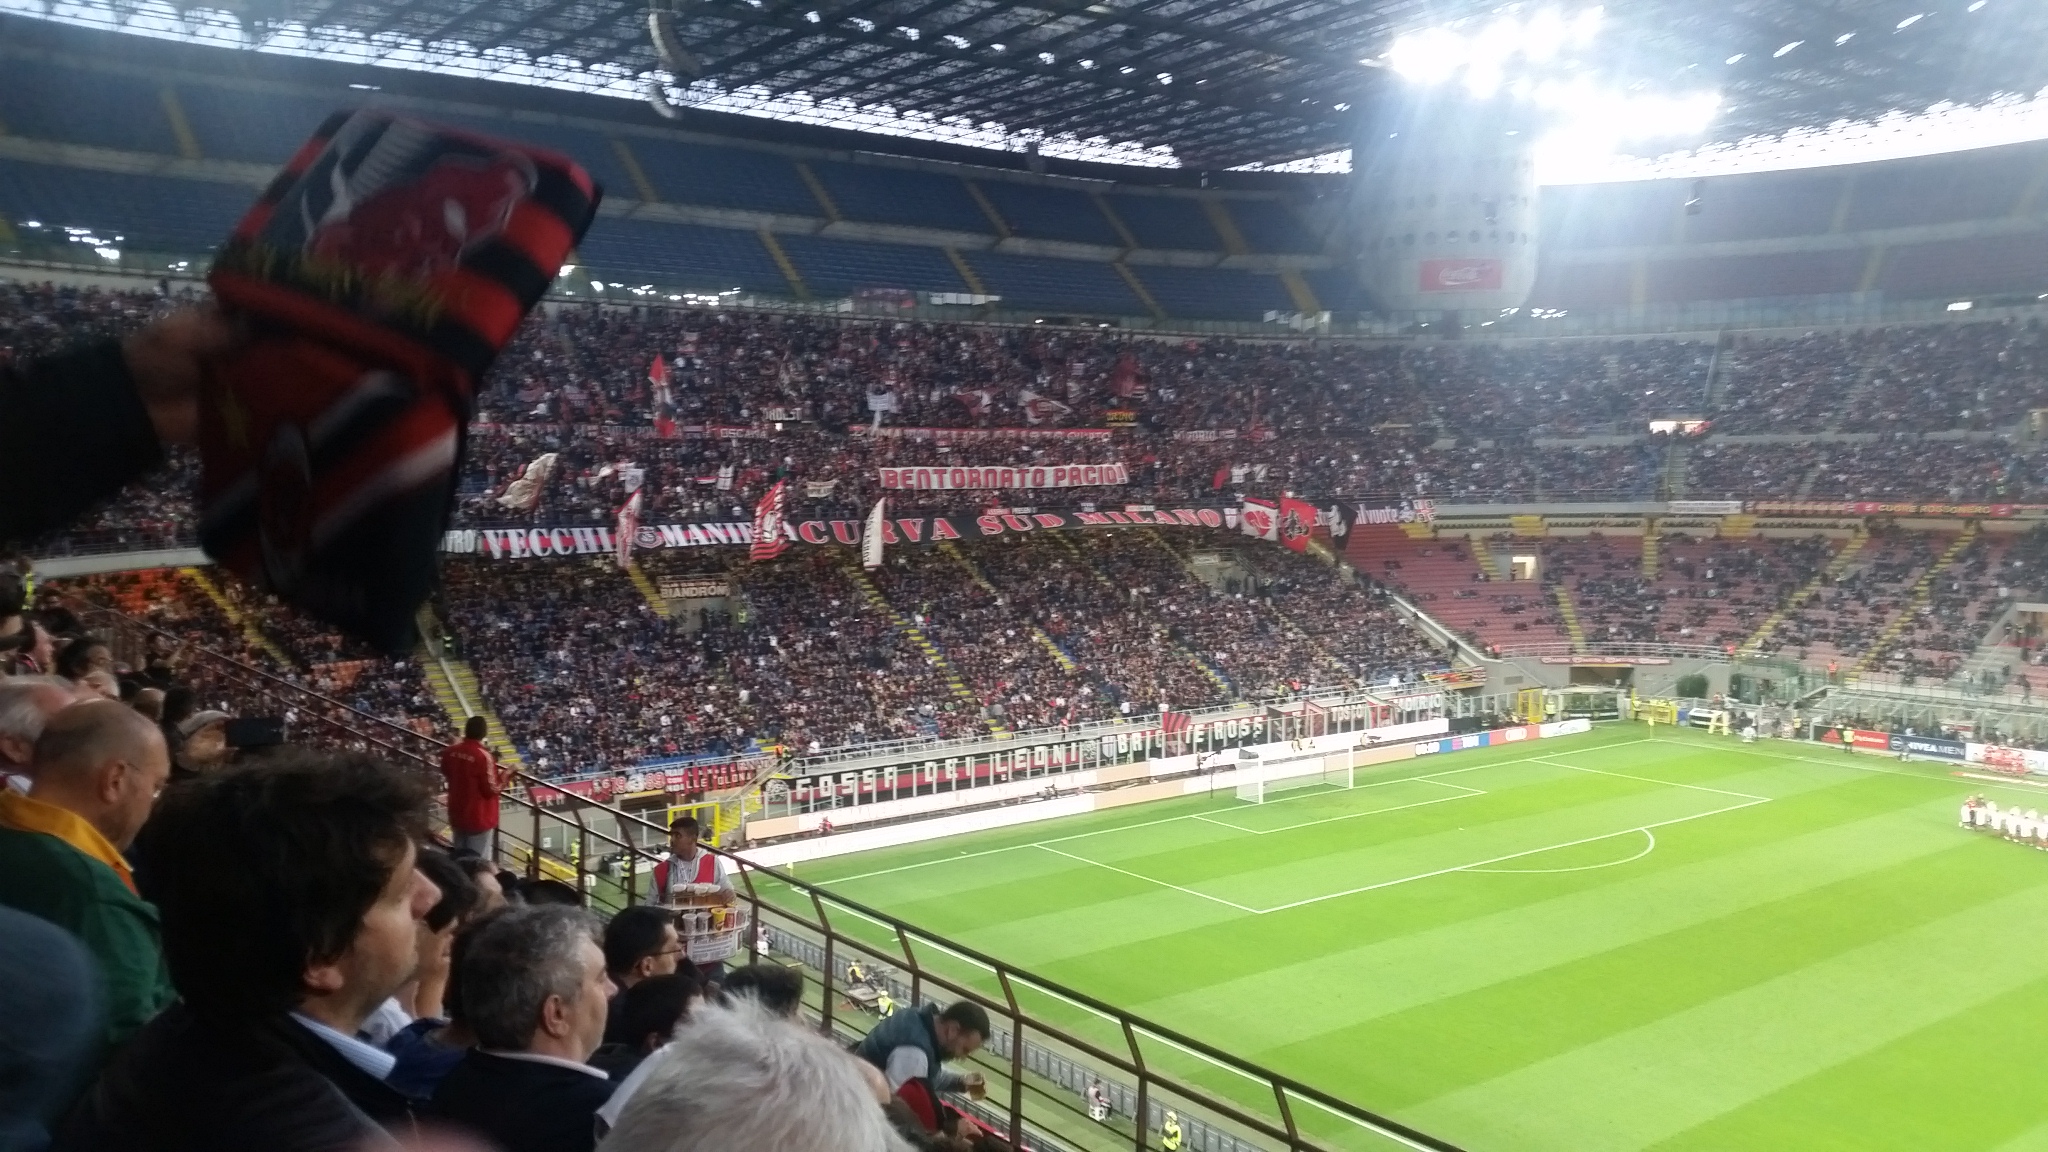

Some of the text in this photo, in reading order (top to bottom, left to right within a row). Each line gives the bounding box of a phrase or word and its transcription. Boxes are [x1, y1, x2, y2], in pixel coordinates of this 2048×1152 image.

[881, 466, 1127, 488] BENTORNATO PACIO!
[657, 521, 799, 547] MANIEA
[977, 513, 1065, 536] SUD
[1073, 508, 1223, 528] MILANO
[482, 527, 617, 559] VECCHI
[1117, 723, 1204, 754] BRIGTE
[1907, 741, 1937, 753] NIVEA
[1937, 746, 1964, 756] MEN
[796, 742, 1077, 800] FOSSA DEI LEONI
